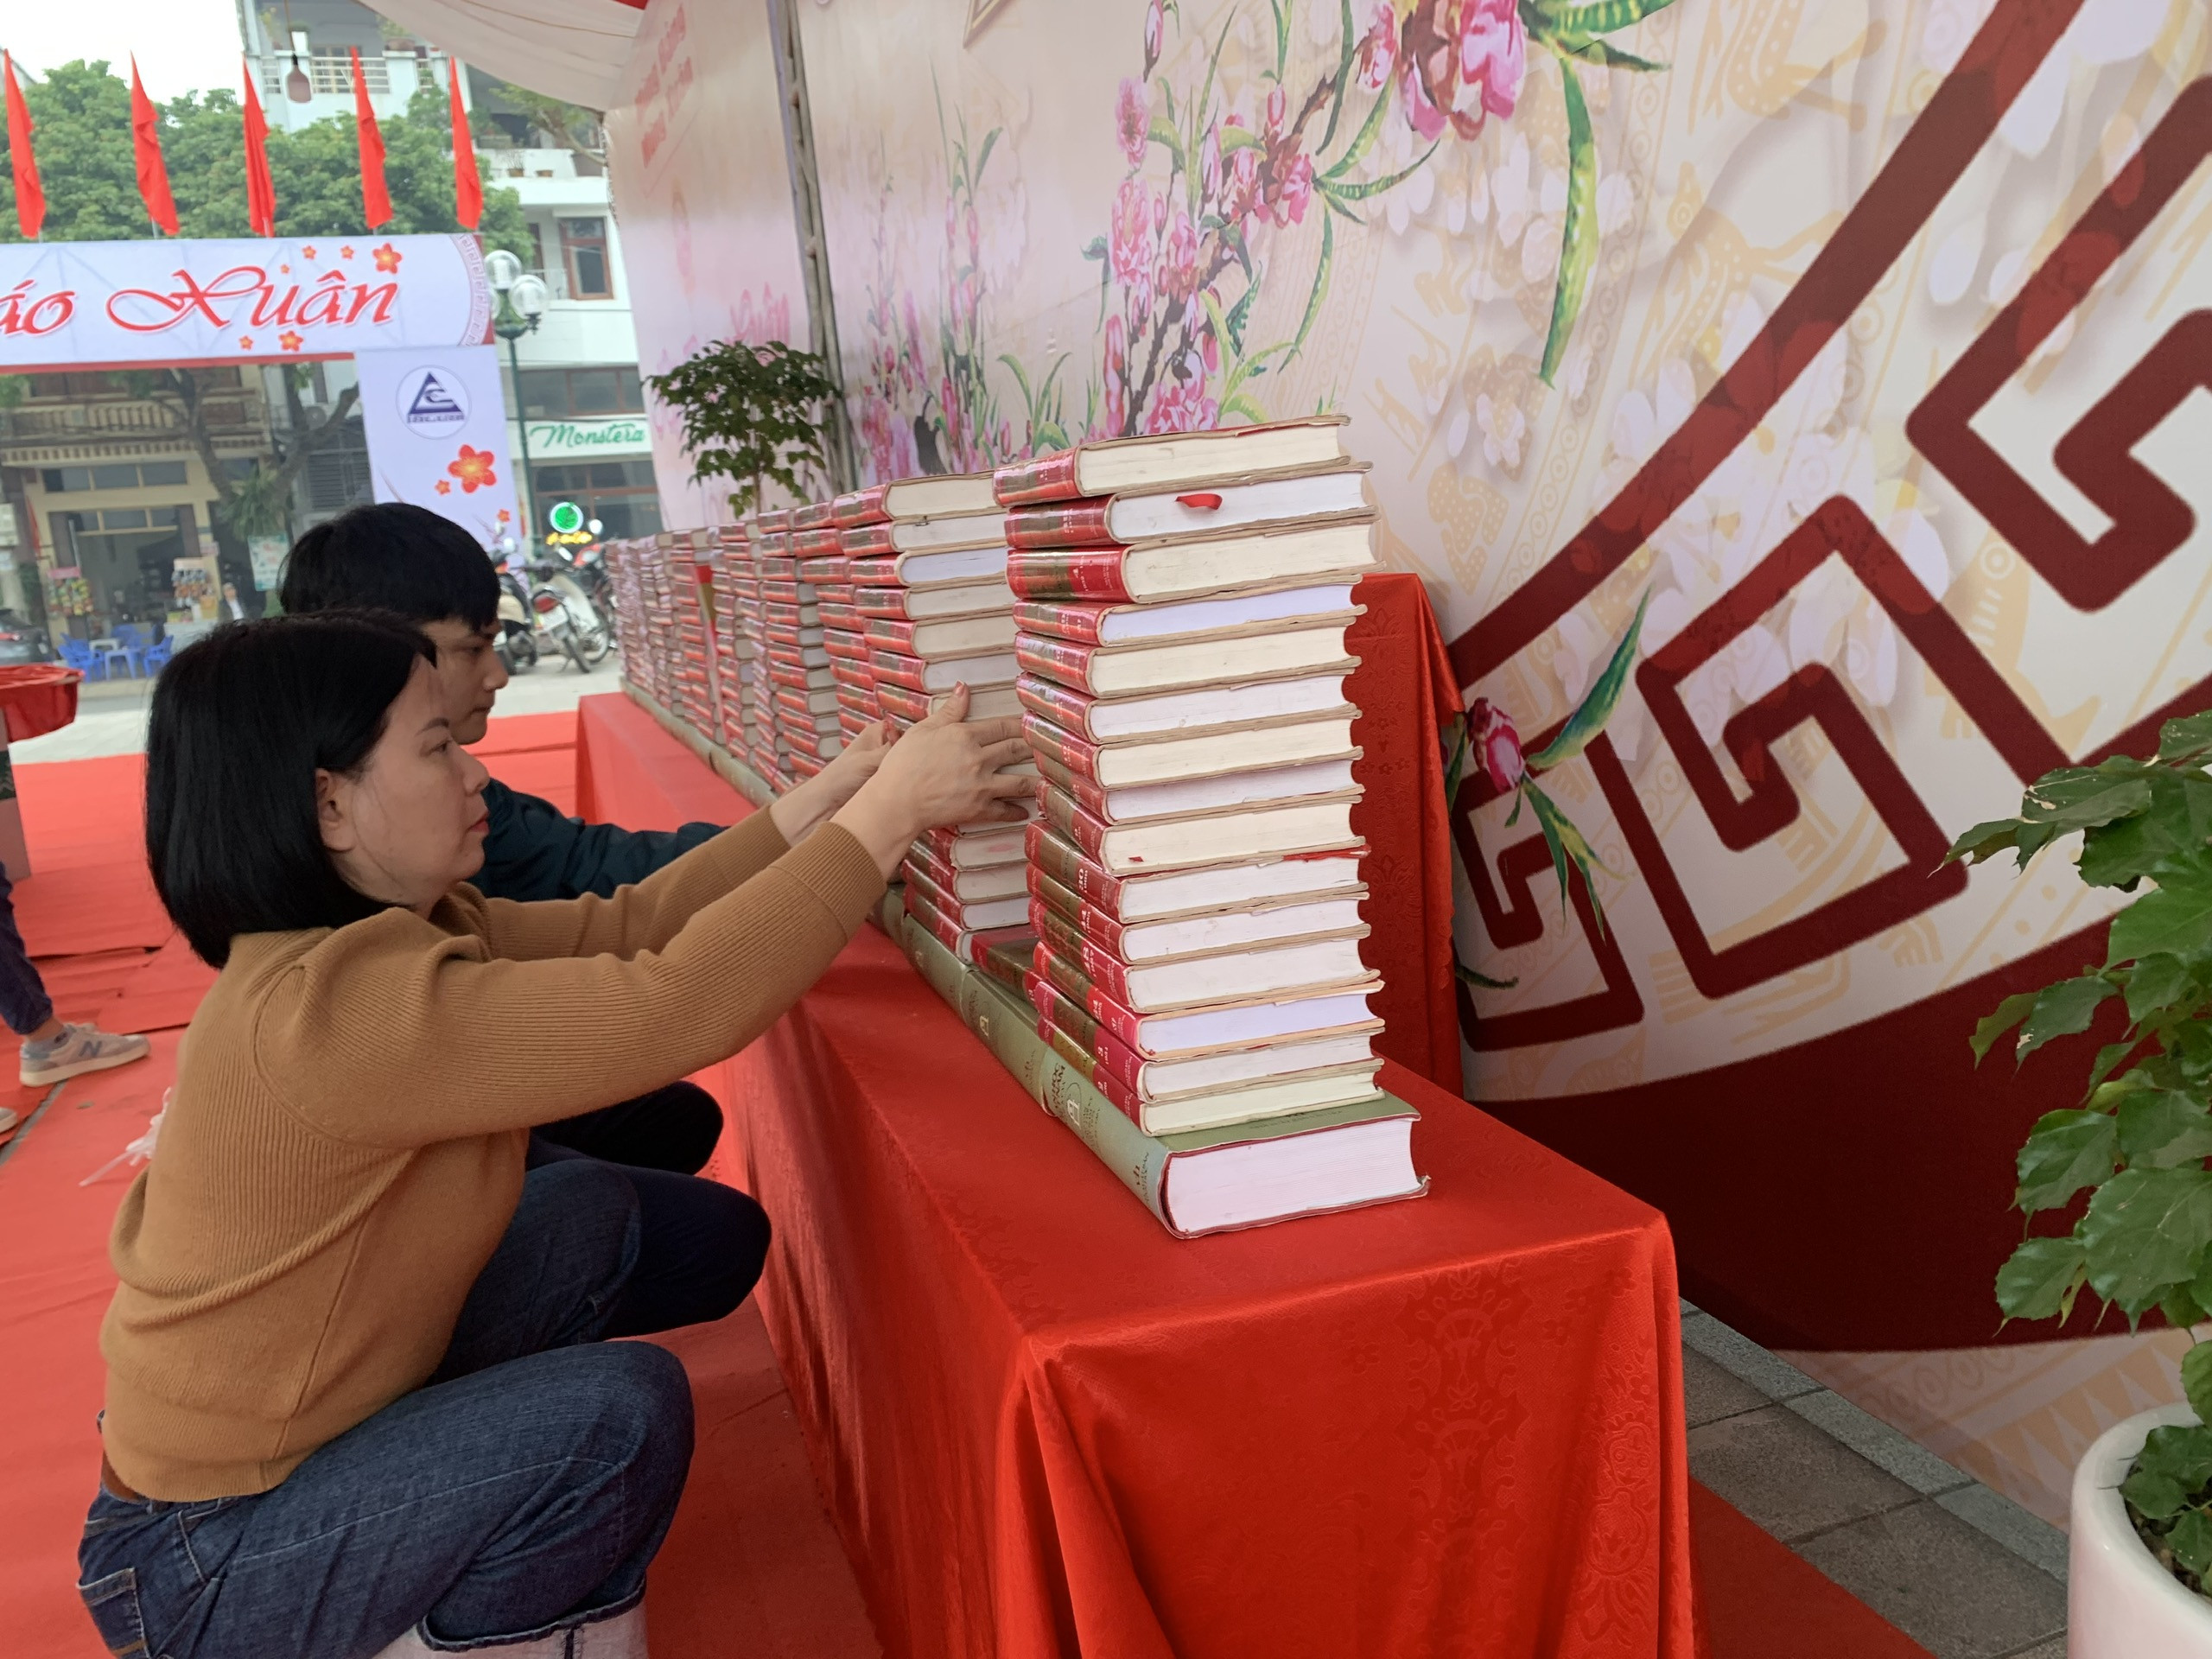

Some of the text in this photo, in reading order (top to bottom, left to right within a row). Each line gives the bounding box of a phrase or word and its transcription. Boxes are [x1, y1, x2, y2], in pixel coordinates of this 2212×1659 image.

[105, 264, 399, 332] Xuân
[530, 423, 645, 448] Monstera
[78, 1040, 103, 1058] N
